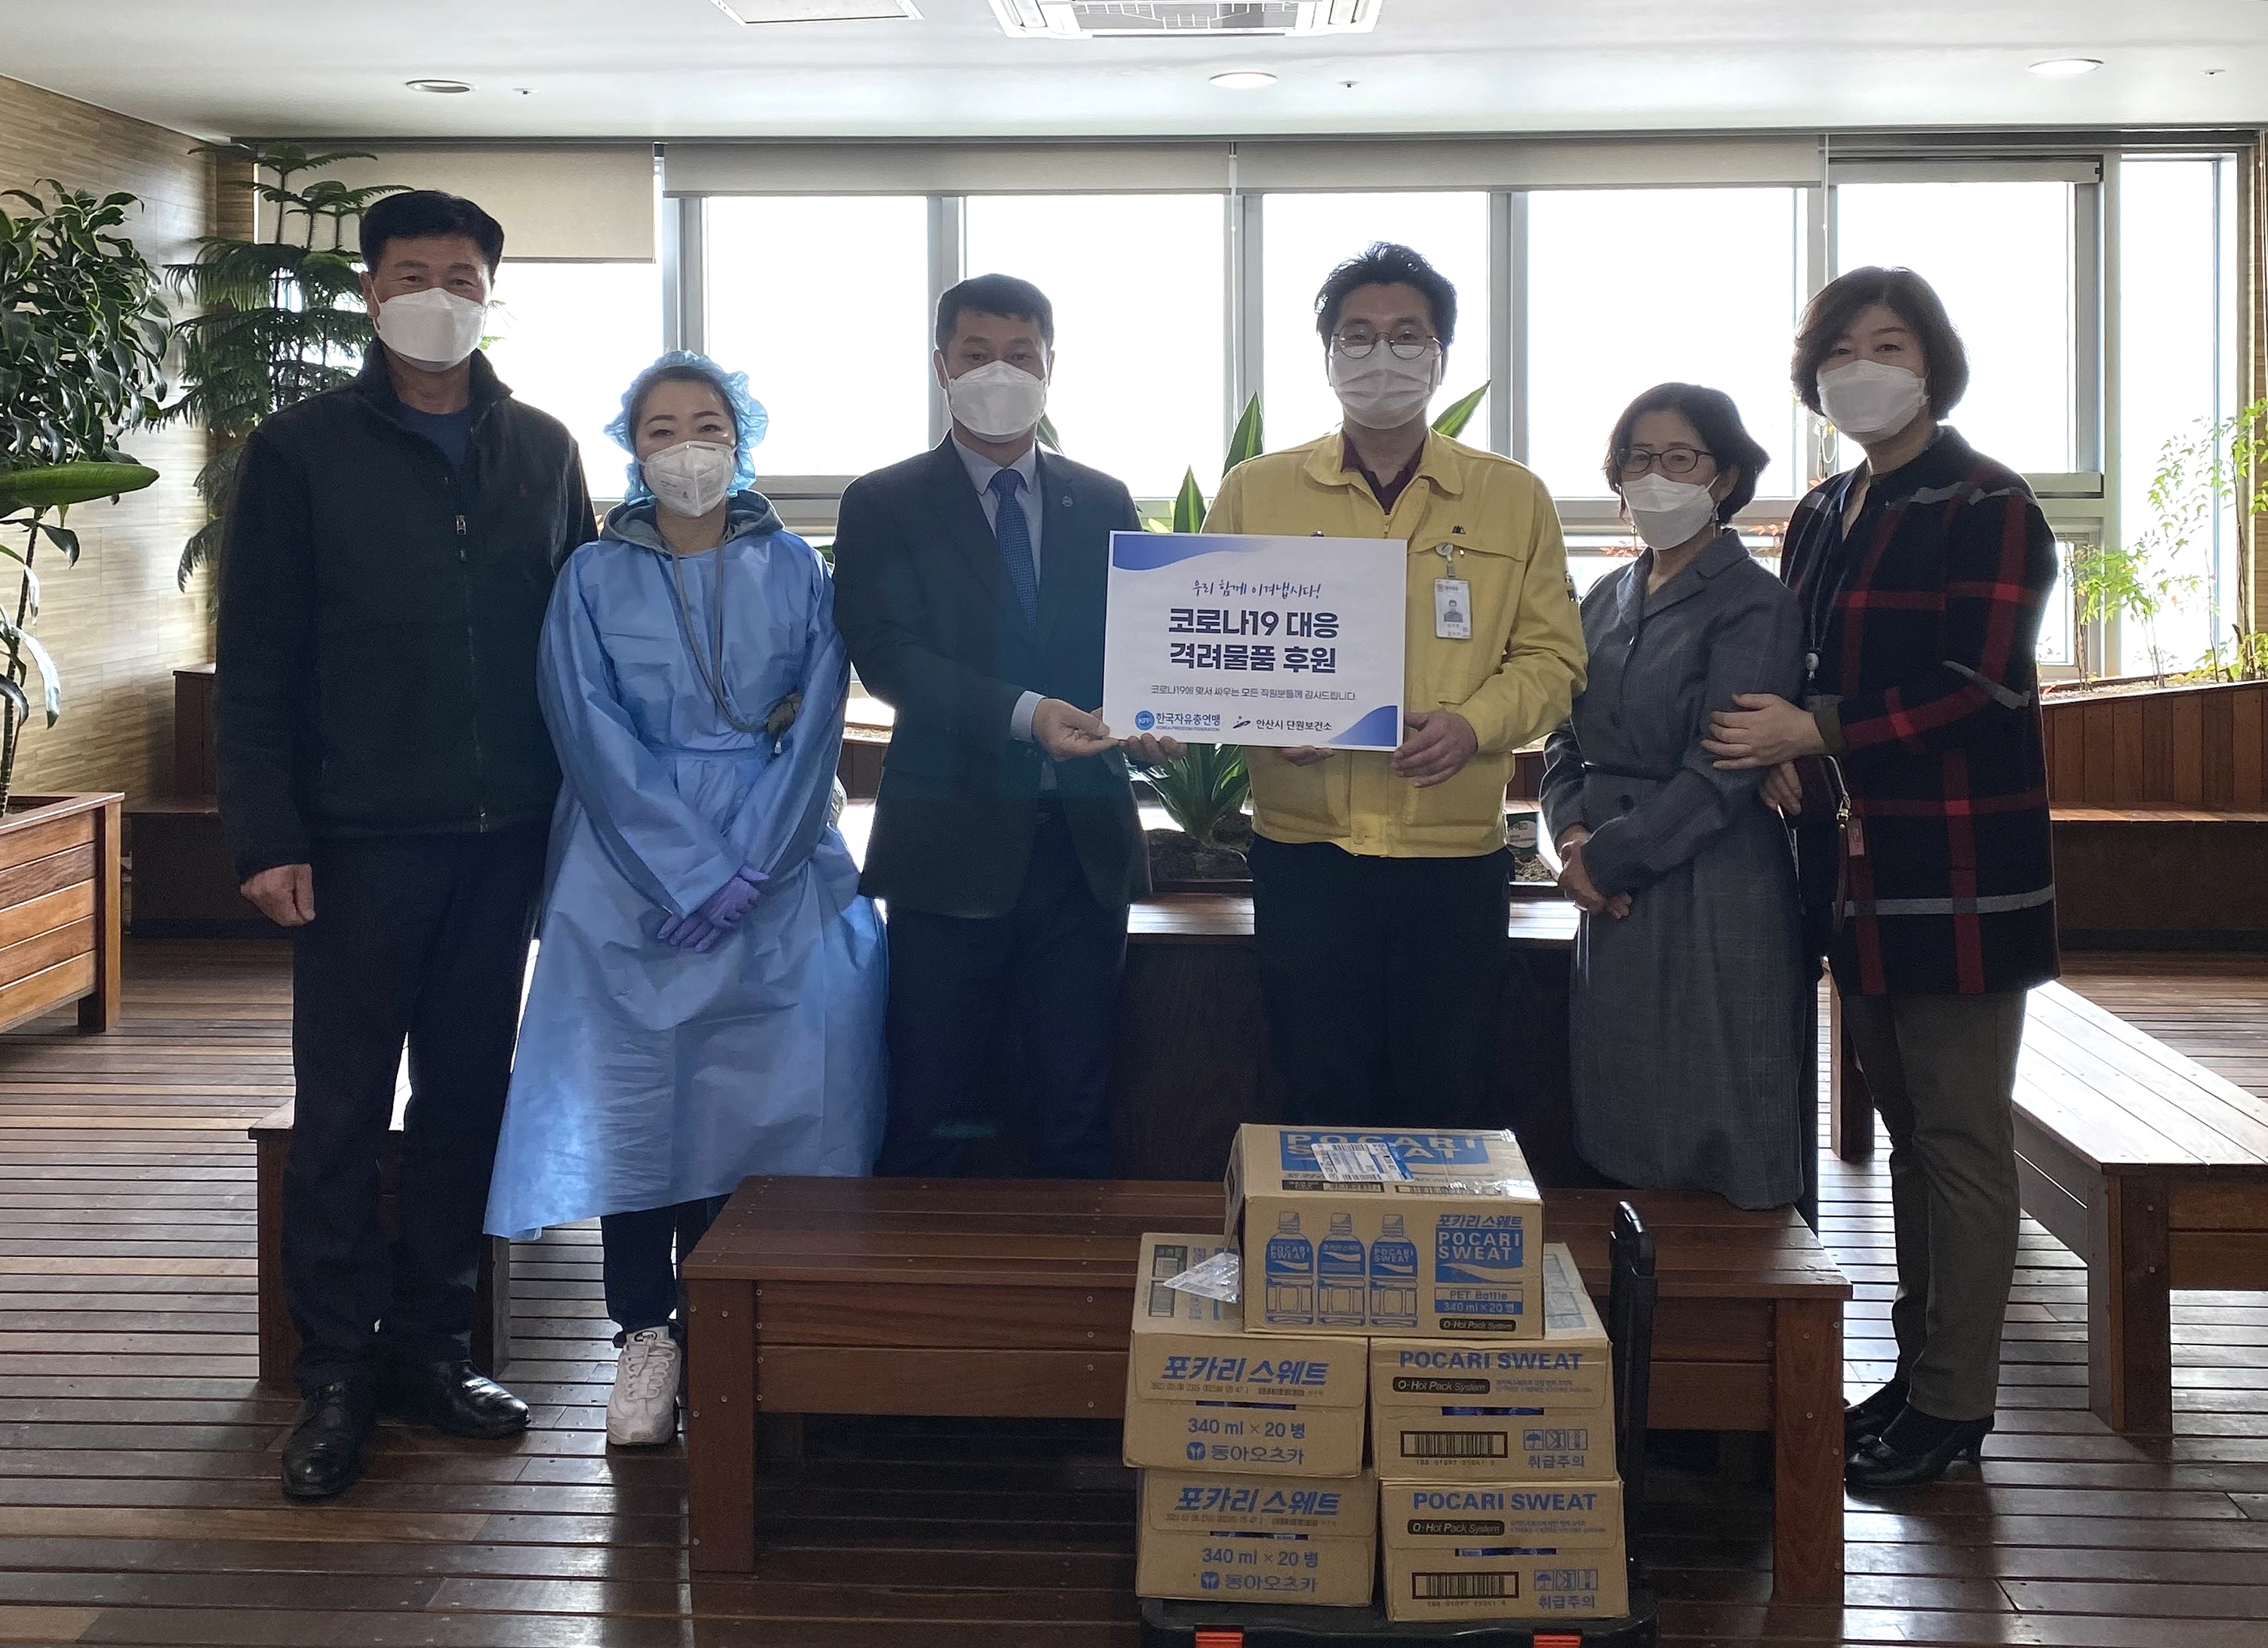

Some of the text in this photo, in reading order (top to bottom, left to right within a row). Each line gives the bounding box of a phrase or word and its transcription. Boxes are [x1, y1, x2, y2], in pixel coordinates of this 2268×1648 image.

[1192, 579, 1321, 599] 우리 함께 이겨냅시다!
[1168, 608, 1339, 639] 코로나19 대응
[1170, 642, 1336, 673] 격려물품 후원
[1151, 685, 1356, 701] 코로나19에 맞서 싸우는 모든 직원분들께 감사드립니다
[1156, 713, 1220, 726] 한국자유총연맹
[1256, 719, 1332, 732] 안산시 단원보건소
[1439, 1231, 1519, 1246] POCARI
[1270, 1246, 1309, 1254] POCARI
[1374, 1248, 1414, 1256] POCARI
[1439, 1246, 1513, 1261] SWEAT
[1450, 1290, 1471, 1300] PET
[1443, 1302, 1463, 1311] 340
[1489, 1303, 1503, 1313] 20
[1399, 1351, 1583, 1370] POCARI SWEAT
[1161, 1356, 1329, 1385] 포카리 스웨트
[1429, 1380, 1454, 1391] Pack
[1454, 1382, 1486, 1393] System
[1188, 1418, 1220, 1434] 340
[1225, 1420, 1243, 1436] ml
[1264, 1422, 1285, 1438] 20
[1290, 1422, 1306, 1439] 병
[1211, 1445, 1304, 1465] 동아오츠카
[1528, 1455, 1584, 1468] 취급주의
[1174, 1487, 1342, 1516] 포카리 스웨트
[1413, 1492, 1597, 1511] POCARI SWEAT
[1412, 1523, 1442, 1533] O-Hot
[1444, 1523, 1467, 1533] Pack
[1469, 1524, 1500, 1535] System
[1202, 1548, 1233, 1563] 340
[1239, 1550, 1257, 1566] ml
[1278, 1551, 1299, 1566] 20
[1303, 1551, 1319, 1569] 병
[1225, 1574, 1318, 1593] 동아오츠카
[1538, 1594, 1596, 1610] 취급주의
